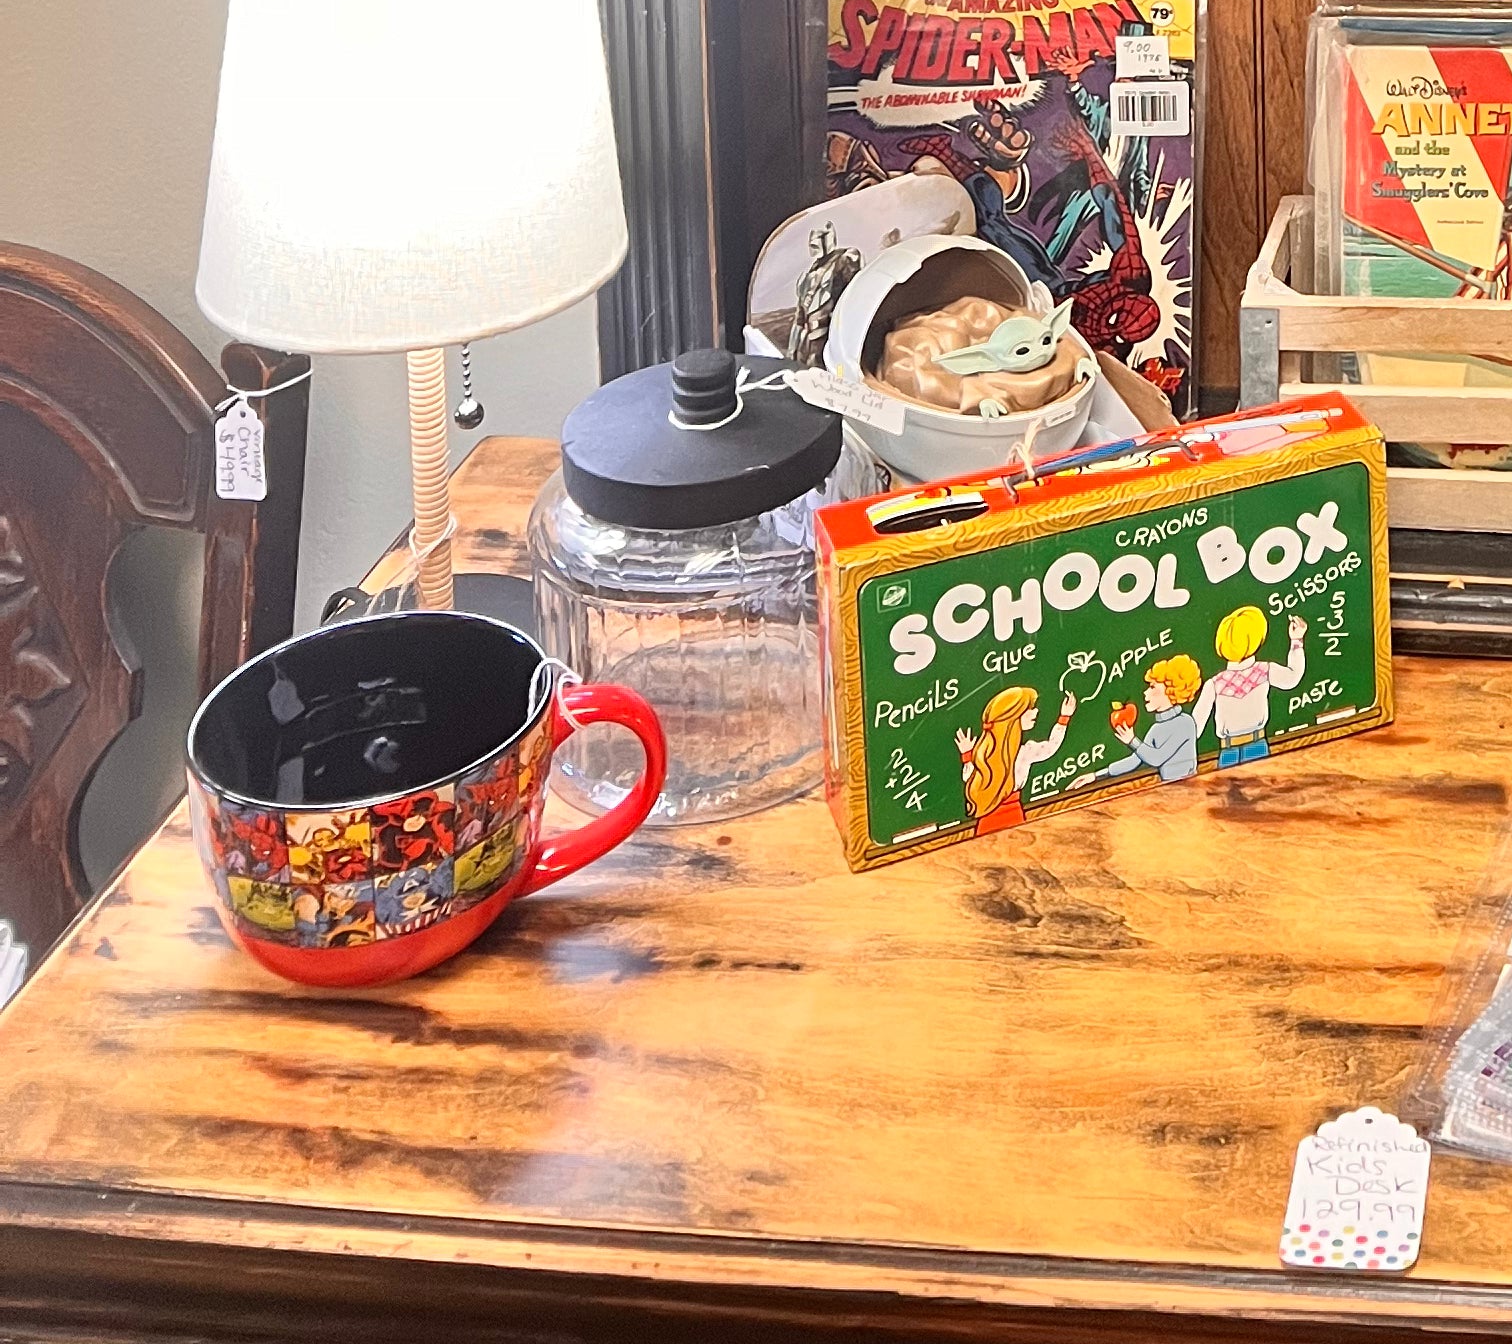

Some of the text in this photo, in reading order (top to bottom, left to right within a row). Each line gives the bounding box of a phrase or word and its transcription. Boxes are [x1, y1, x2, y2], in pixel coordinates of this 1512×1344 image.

[861, 97, 884, 110] THE
[1395, 140, 1450, 156] and the
[1383, 161, 1467, 179] Mystery at
[1453, 183, 1489, 198] Cove
[237, 427, 250, 476] Chair
[1115, 507, 1209, 548] CRAYONS
[889, 500, 1350, 676] SCHOOL BOX
[1328, 590, 1346, 610] 5
[1324, 635, 1343, 657] 2
[888, 748, 906, 770] 2
[905, 791, 928, 813] 4
[1328, 1174, 1417, 1195] Desk
[1301, 1198, 1416, 1222] 129.99
